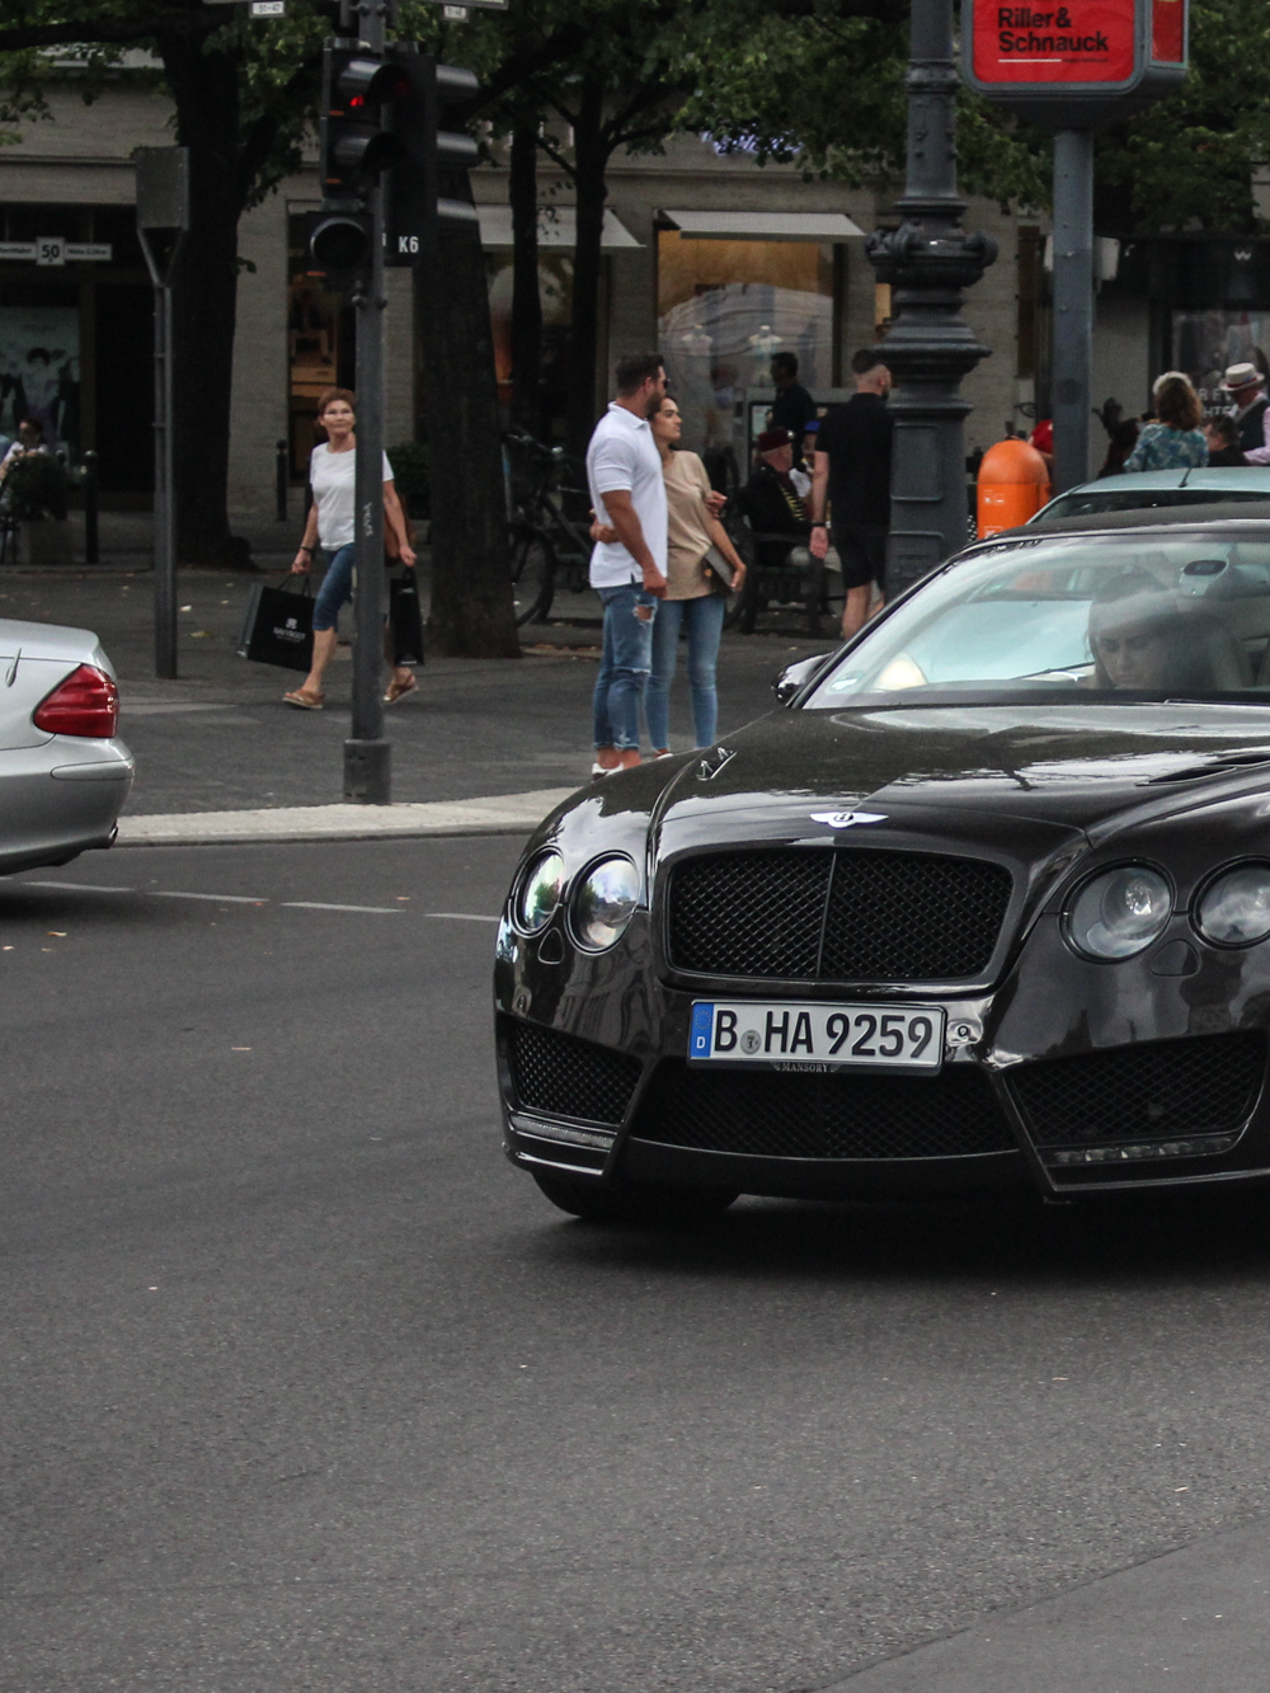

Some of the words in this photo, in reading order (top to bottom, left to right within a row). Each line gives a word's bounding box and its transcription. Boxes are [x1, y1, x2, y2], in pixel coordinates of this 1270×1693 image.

[997, 7, 1053, 28] Riller
[1055, 7, 1072, 28] &
[998, 31, 1109, 52] Schnauck
[41, 244, 60, 259] 50
[398, 235, 419, 253] K6
[696, 1036, 706, 1049] D
[714, 1010, 738, 1052] B
[764, 1011, 814, 1053] HA
[825, 1013, 933, 1059] 9259
[782, 1062, 830, 1073] MANSORY
